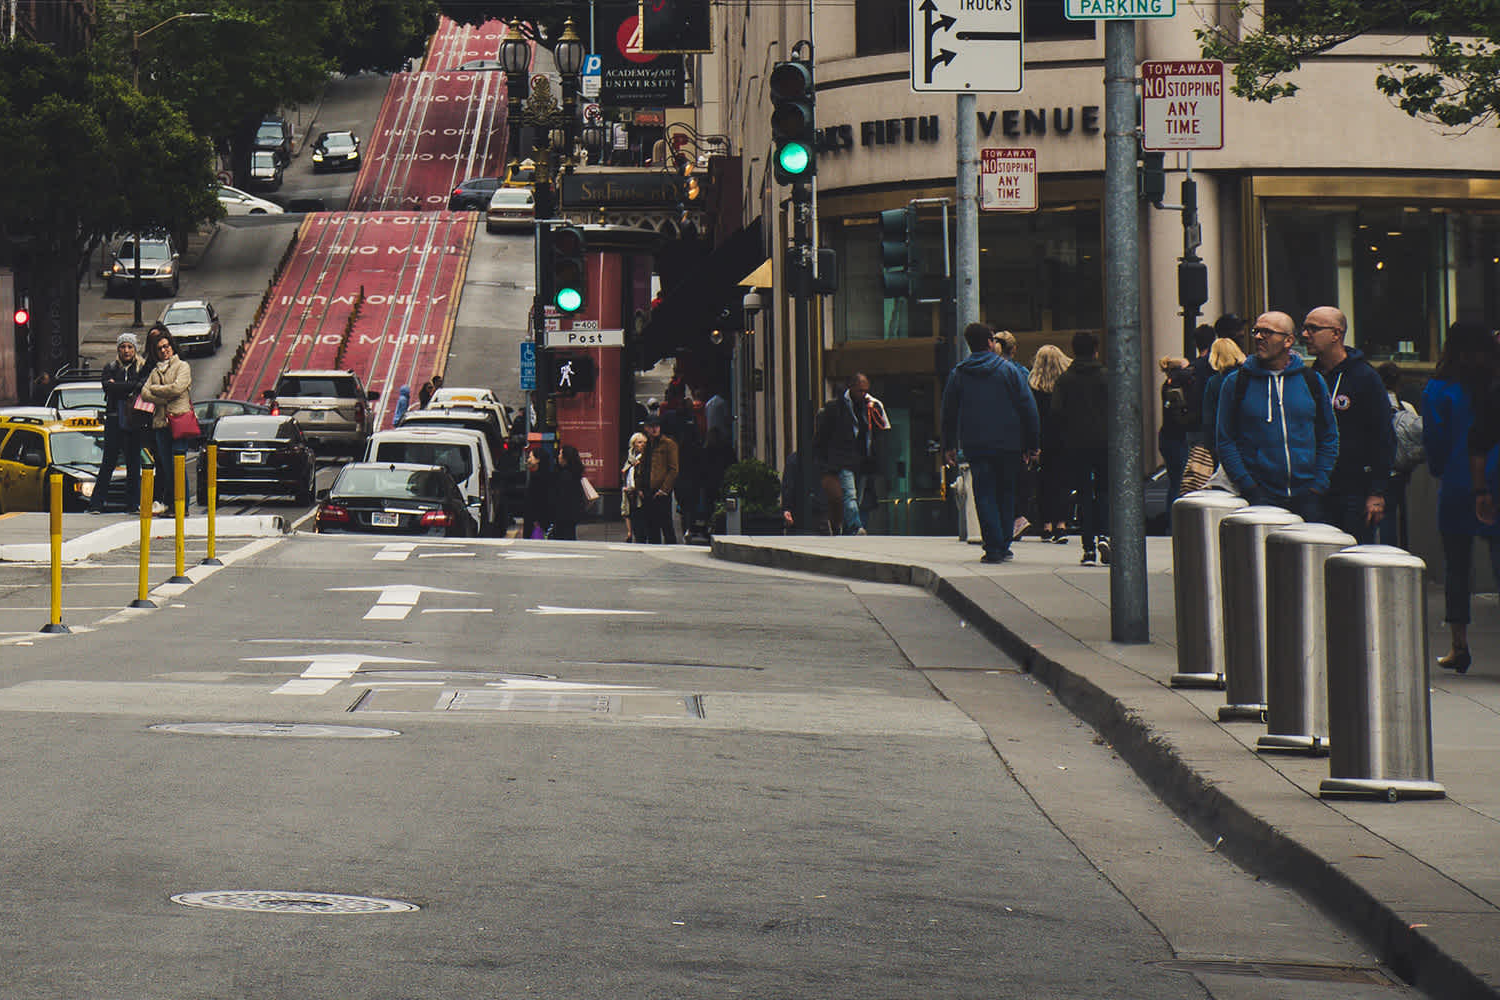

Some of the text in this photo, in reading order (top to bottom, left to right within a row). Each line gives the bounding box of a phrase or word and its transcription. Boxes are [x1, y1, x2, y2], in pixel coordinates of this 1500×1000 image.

[606, 69, 650, 77] ACADEMY
[657, 69, 676, 77] ART
[1148, 64, 1214, 75] TOW-AWAY
[605, 80, 677, 88] UNIVERSITY
[1144, 77, 1221, 97] NO STOPPING
[1167, 101, 1199, 117] ANY
[861, 115, 939, 146] FIFTH
[976, 106, 1100, 137] VENUE
[1165, 119, 1201, 135] TIME
[984, 150, 1034, 158] TOW-AWAY
[982, 160, 1034, 174] NO STOPPING
[998, 176, 1020, 186] ANY
[997, 188, 1020, 199] TIME
[318, 216, 383, 225] MUNI
[393, 216, 465, 225] ONLY
[387, 246, 455, 254] MUNI
[281, 295, 355, 305] MUNI
[366, 294, 447, 305] ONLY
[581, 321, 597, 329] 400
[259, 334, 343, 345] ONLY
[359, 334, 435, 345] MUNI
[568, 333, 603, 343] Post
[72, 418, 98, 426] TAXI
